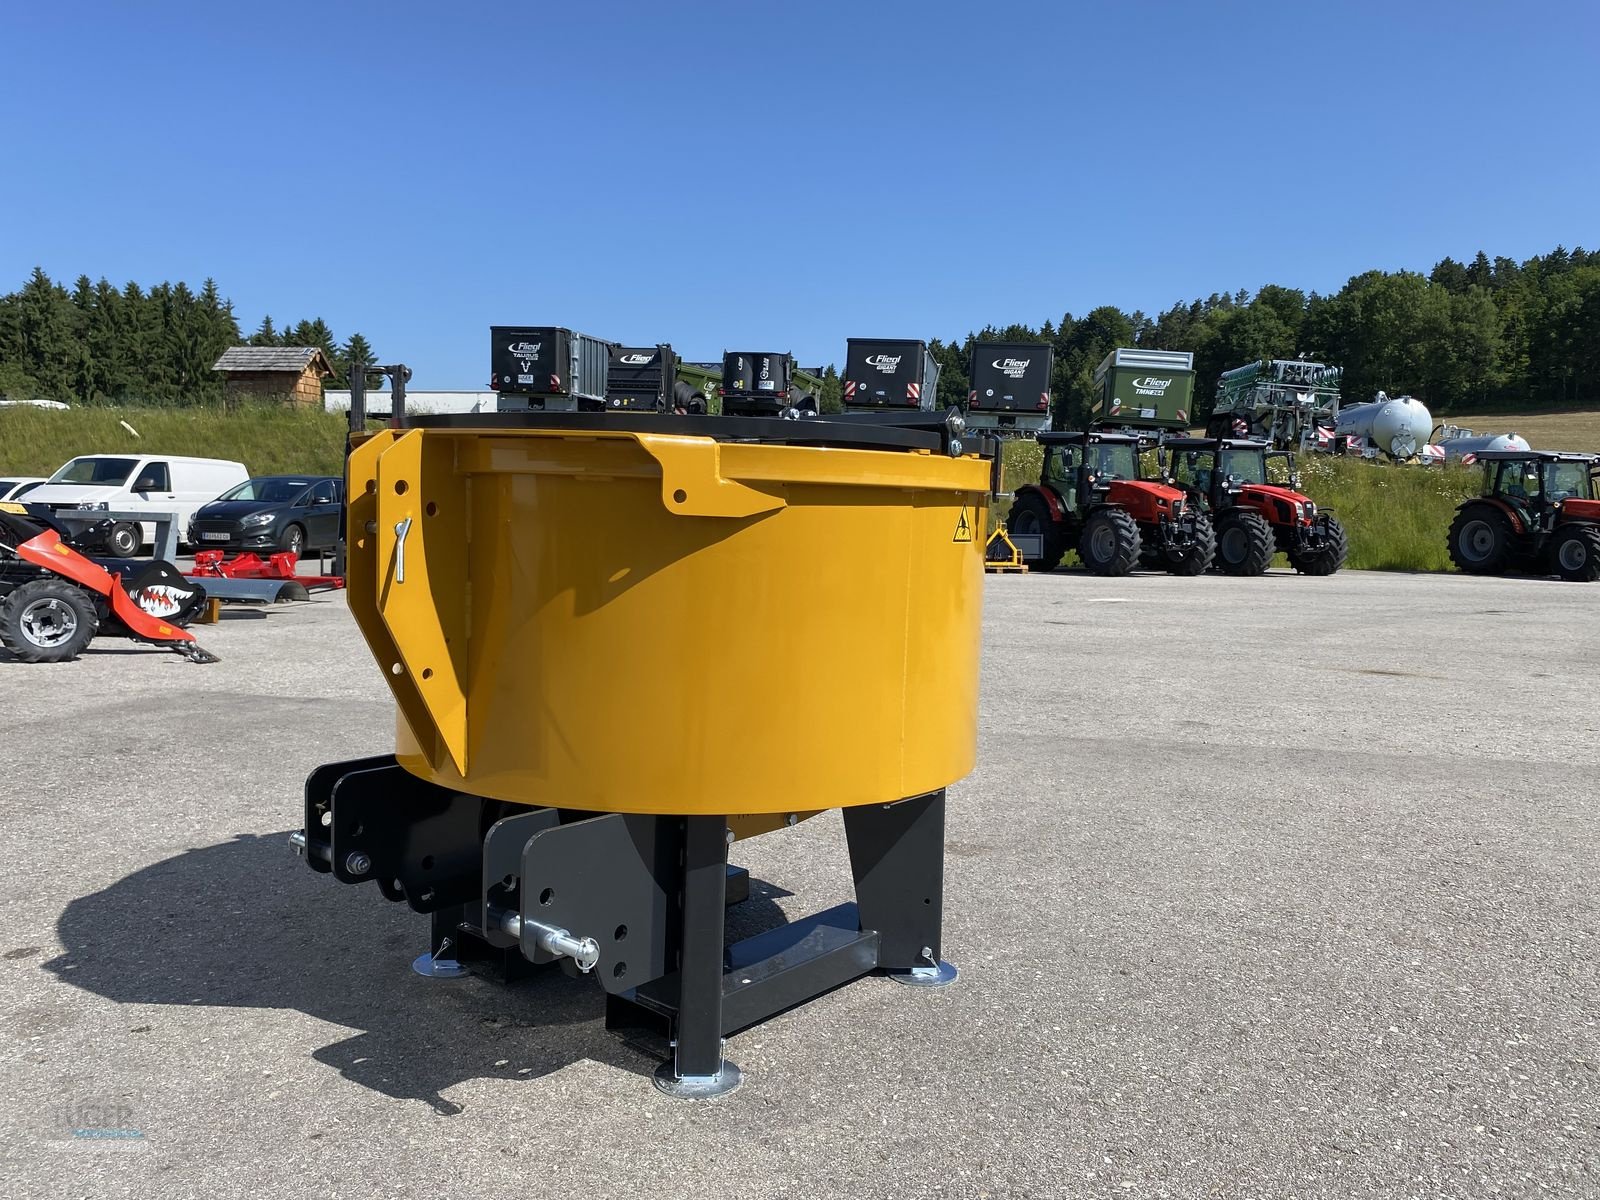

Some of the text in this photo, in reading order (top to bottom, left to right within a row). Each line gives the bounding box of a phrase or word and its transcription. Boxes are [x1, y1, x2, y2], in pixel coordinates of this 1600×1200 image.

[518, 342, 542, 352] Fliegl
[876, 354, 902, 364] Fliegl
[1003, 358, 1031, 368] Fliegl
[1144, 377, 1172, 388] Fliegl
